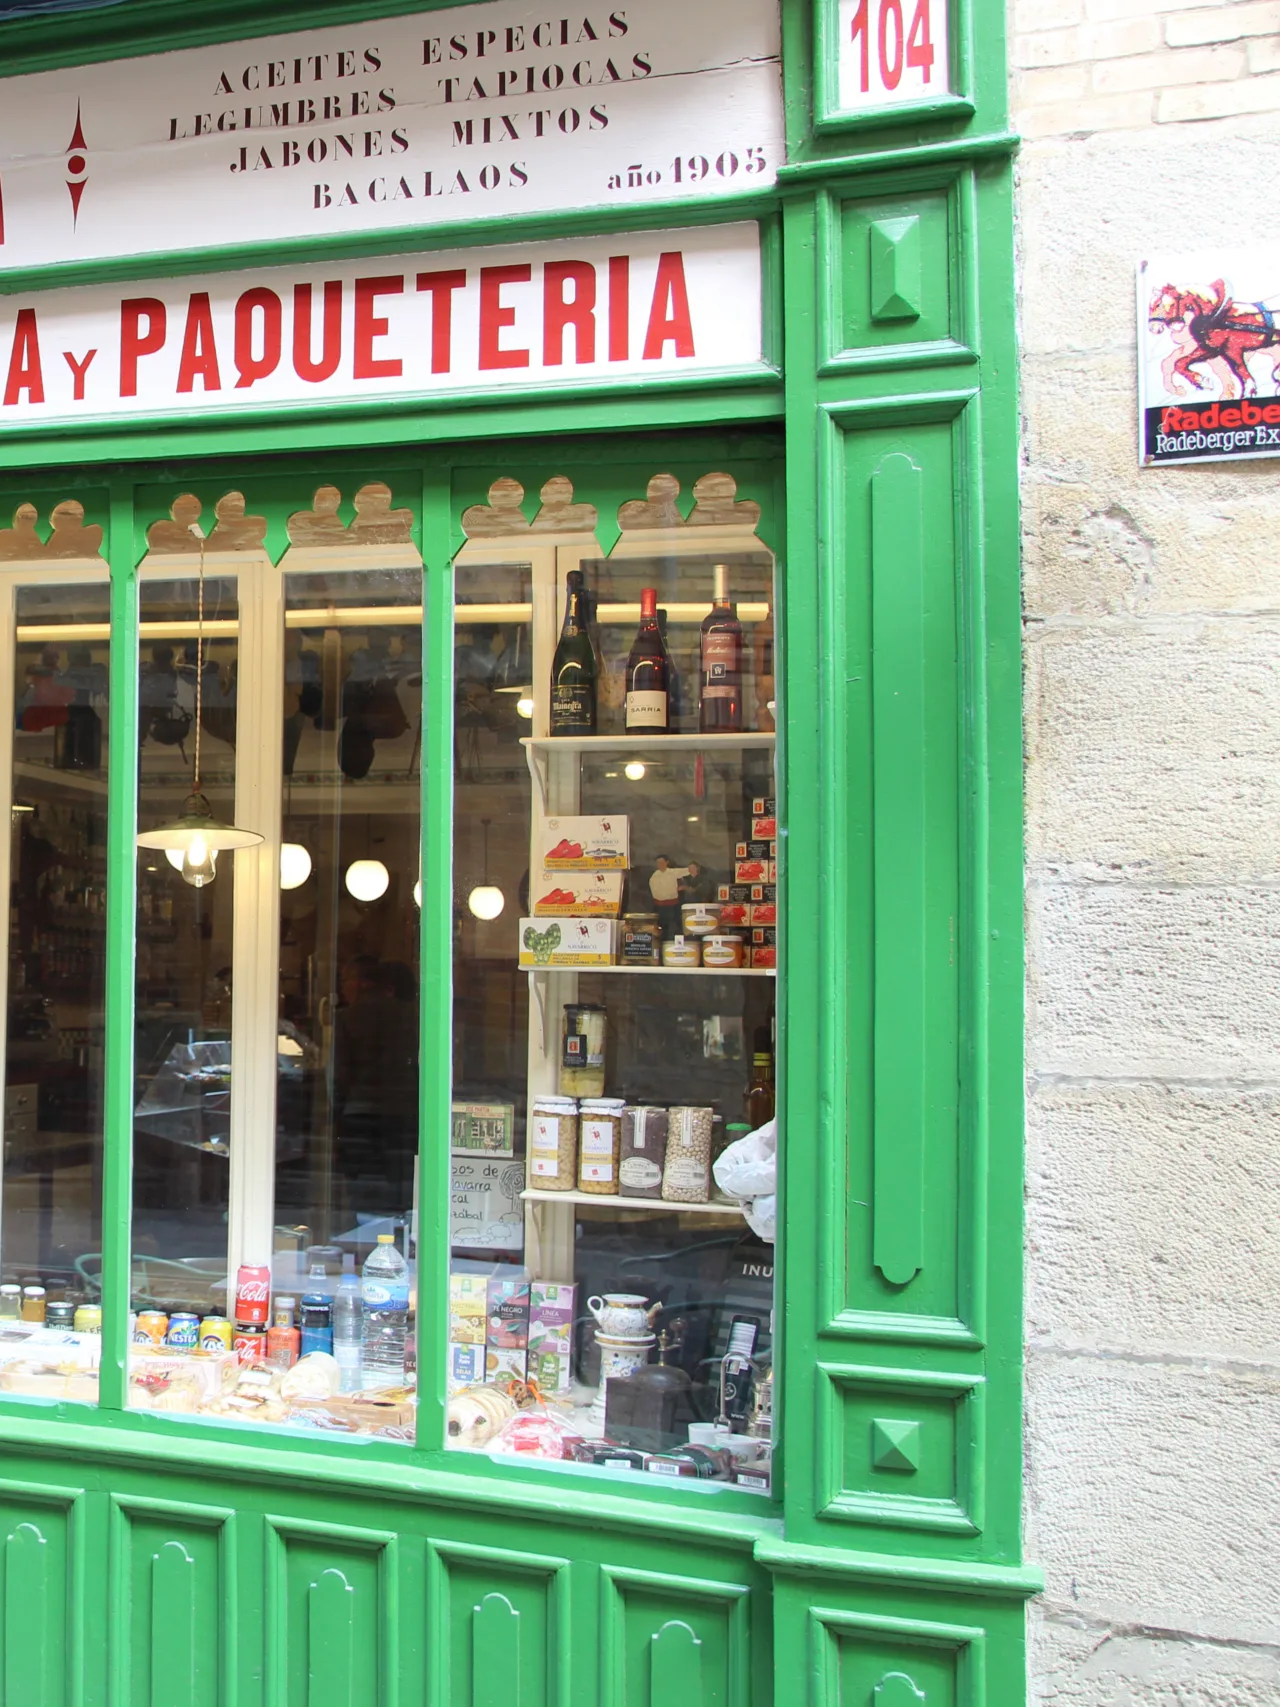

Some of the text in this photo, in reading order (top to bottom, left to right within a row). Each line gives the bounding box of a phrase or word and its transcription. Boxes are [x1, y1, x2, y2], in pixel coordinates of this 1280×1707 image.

[213, 11, 629, 95] ACEITES ESPECIAS
[851, 0, 934, 92] 104
[169, 52, 652, 140] LEGUMBRES TAPIOCAS
[229, 104, 609, 173] JABONES MIXTOS
[313, 160, 528, 209] BACALAOS
[608, 146, 767, 190] año 1905
[63, 349, 97, 400] Y
[119, 251, 696, 396] PAQUETERIA
[1155, 429, 1254, 454] Radeberger
[452, 1181, 492, 1192] avarra
[483, 1164, 499, 1177] de
[501, 1306, 523, 1314] NEGRO
[170, 1333, 198, 1344] NESTEA
